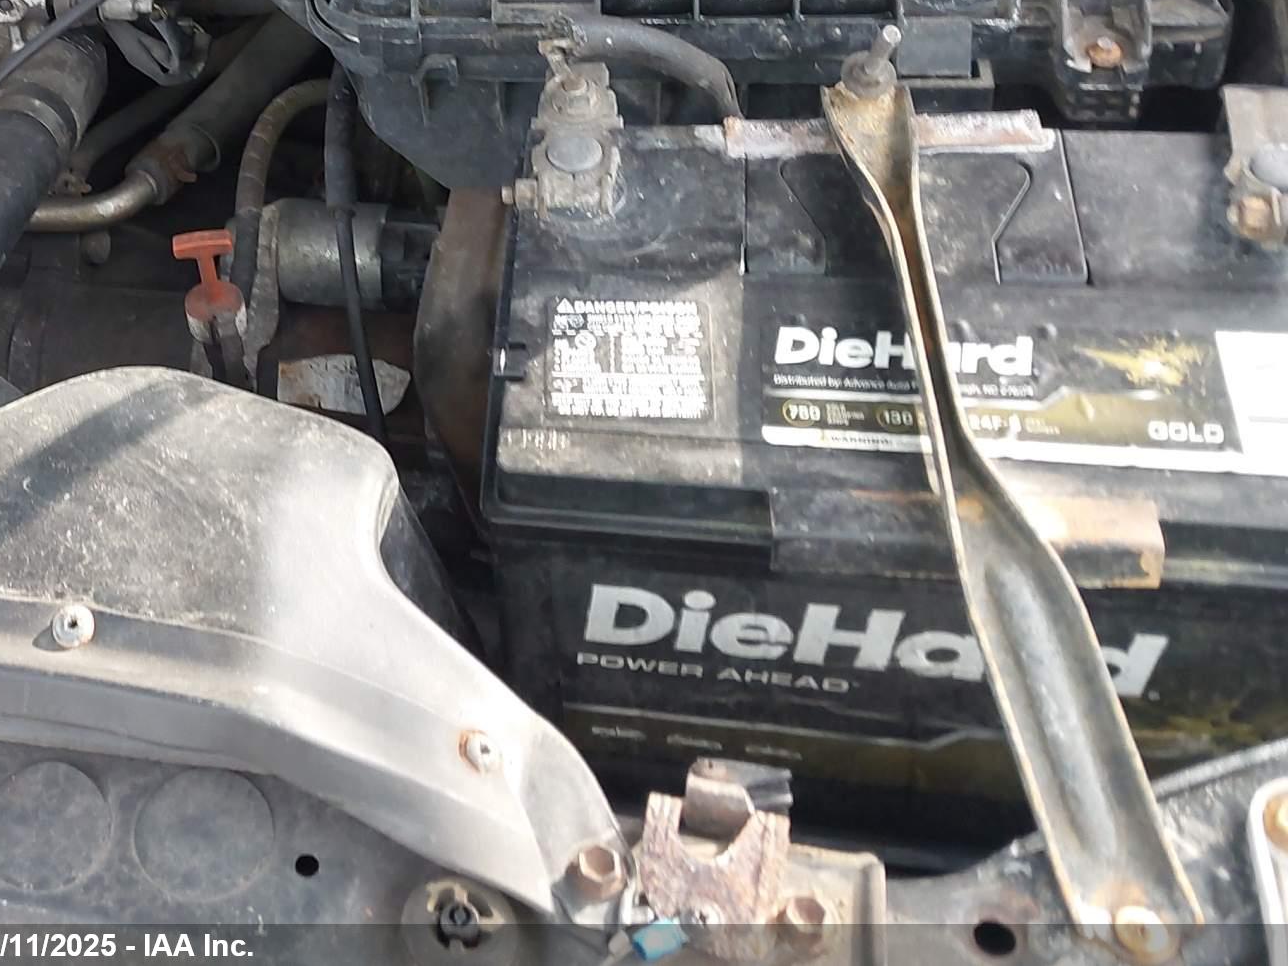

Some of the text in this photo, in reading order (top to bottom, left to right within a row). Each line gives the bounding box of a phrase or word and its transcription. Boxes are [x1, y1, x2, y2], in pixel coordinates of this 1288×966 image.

[1147, 420, 1225, 444] GOLD
[584, 583, 1169, 696] DieHad
[576, 652, 850, 693] POWER AHEAD
